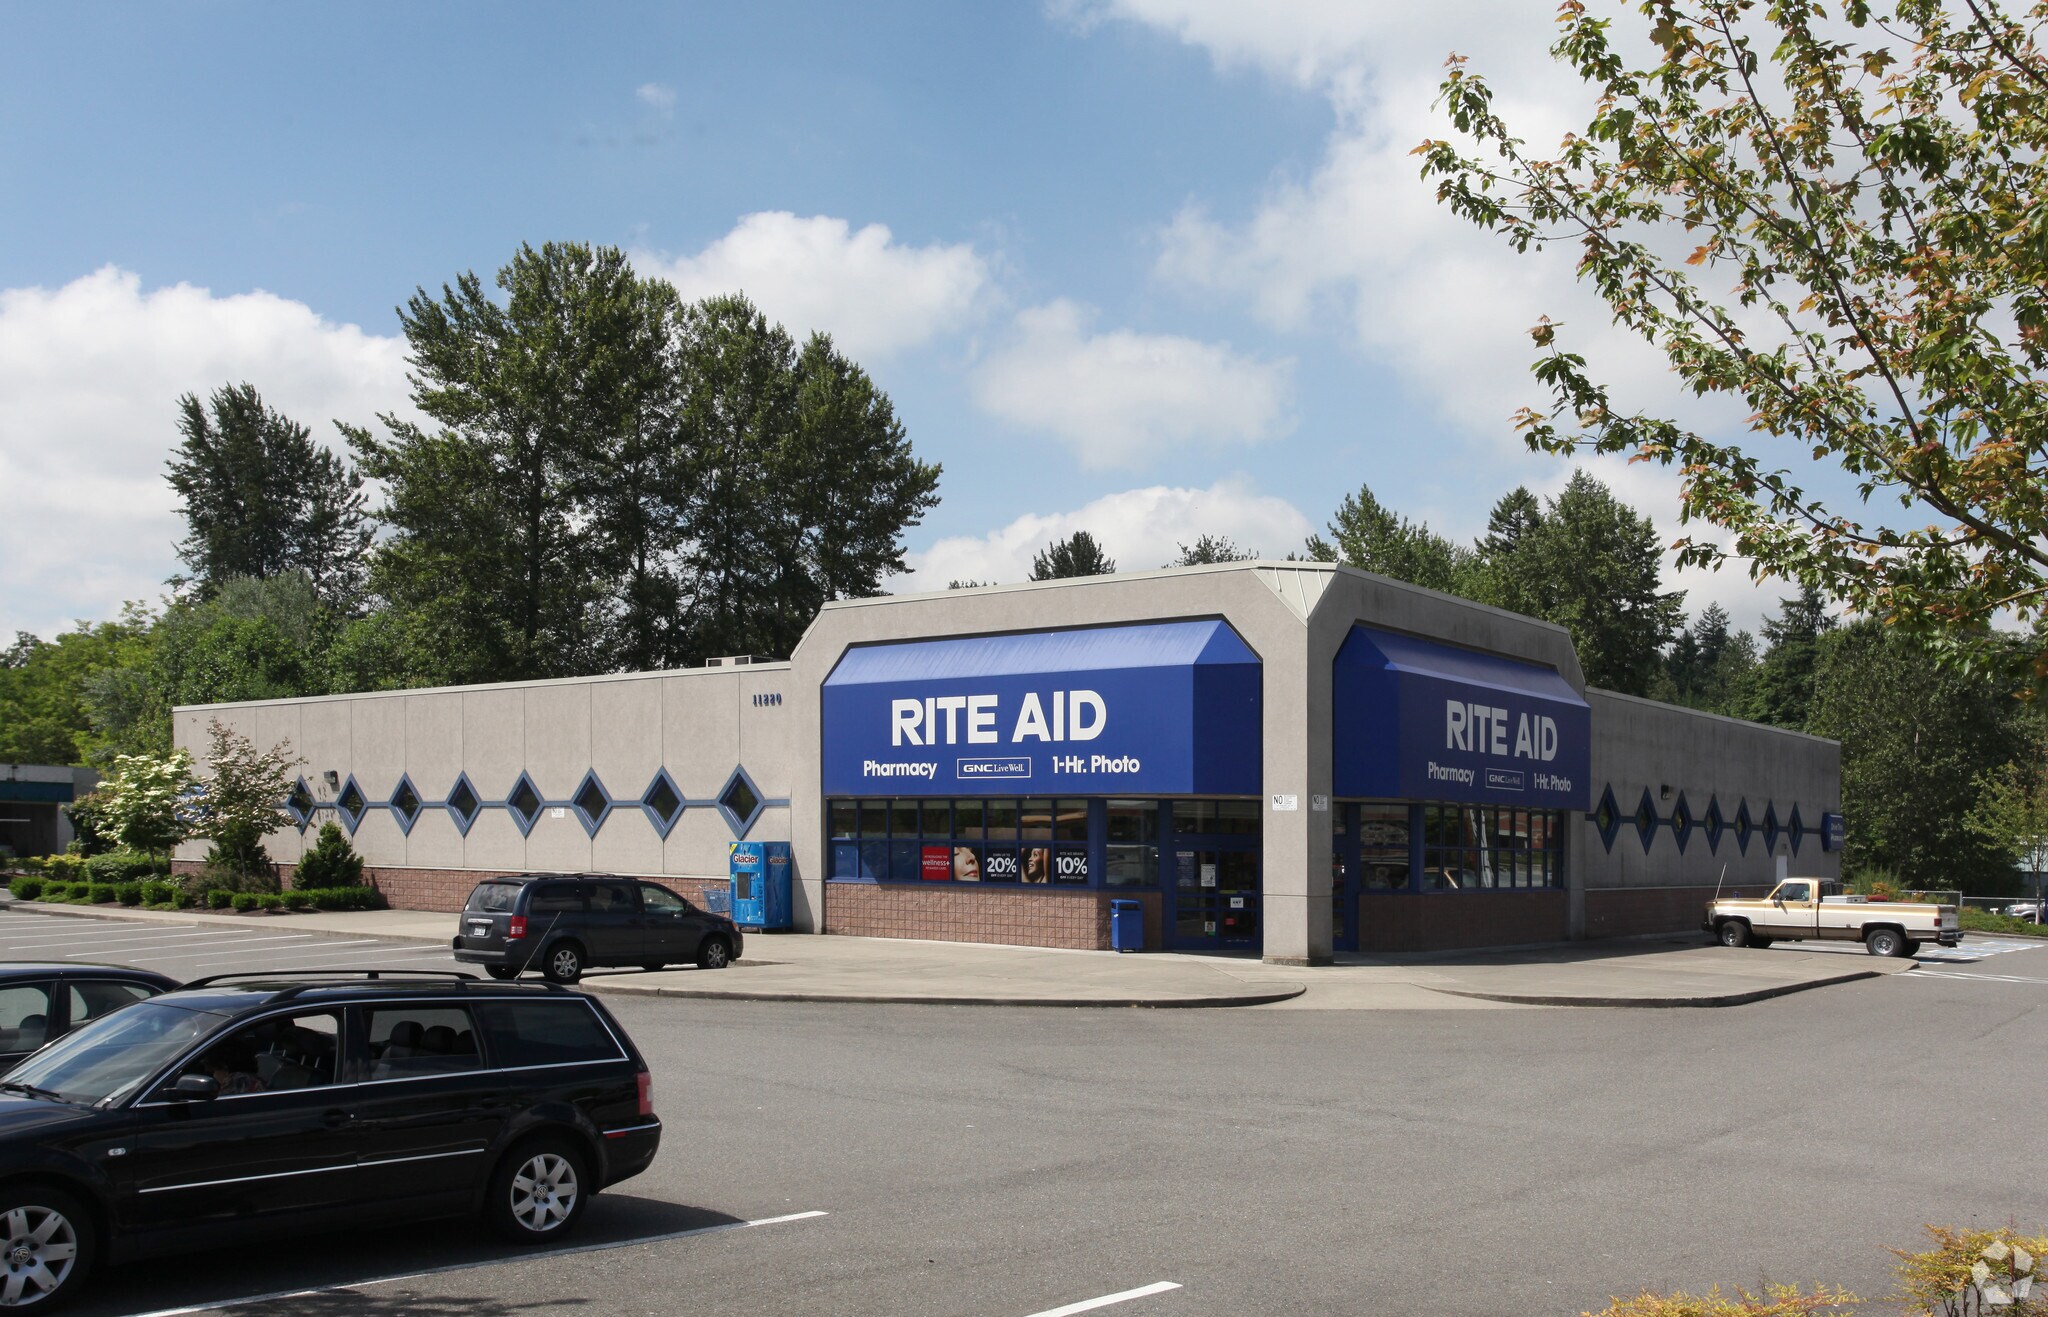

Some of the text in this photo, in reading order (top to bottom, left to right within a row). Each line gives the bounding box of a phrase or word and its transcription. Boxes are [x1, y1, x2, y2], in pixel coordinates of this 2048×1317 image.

[892, 689, 1107, 746] RITE AID
[1446, 699, 1558, 762] RITE AID
[863, 760, 937, 779] Pharmacy
[963, 764, 993, 773] GNC
[1052, 755, 1141, 774] 1-Hr. Photo
[1428, 761, 1475, 787] Pharmacy
[1489, 774, 1505, 783] GNC
[1533, 772, 1572, 792] 1-Hr. Photo
[1273, 795, 1284, 805] NO
[733, 854, 759, 864] Glacier
[987, 857, 1017, 873] 20%
[1056, 856, 1088, 874] 10%
